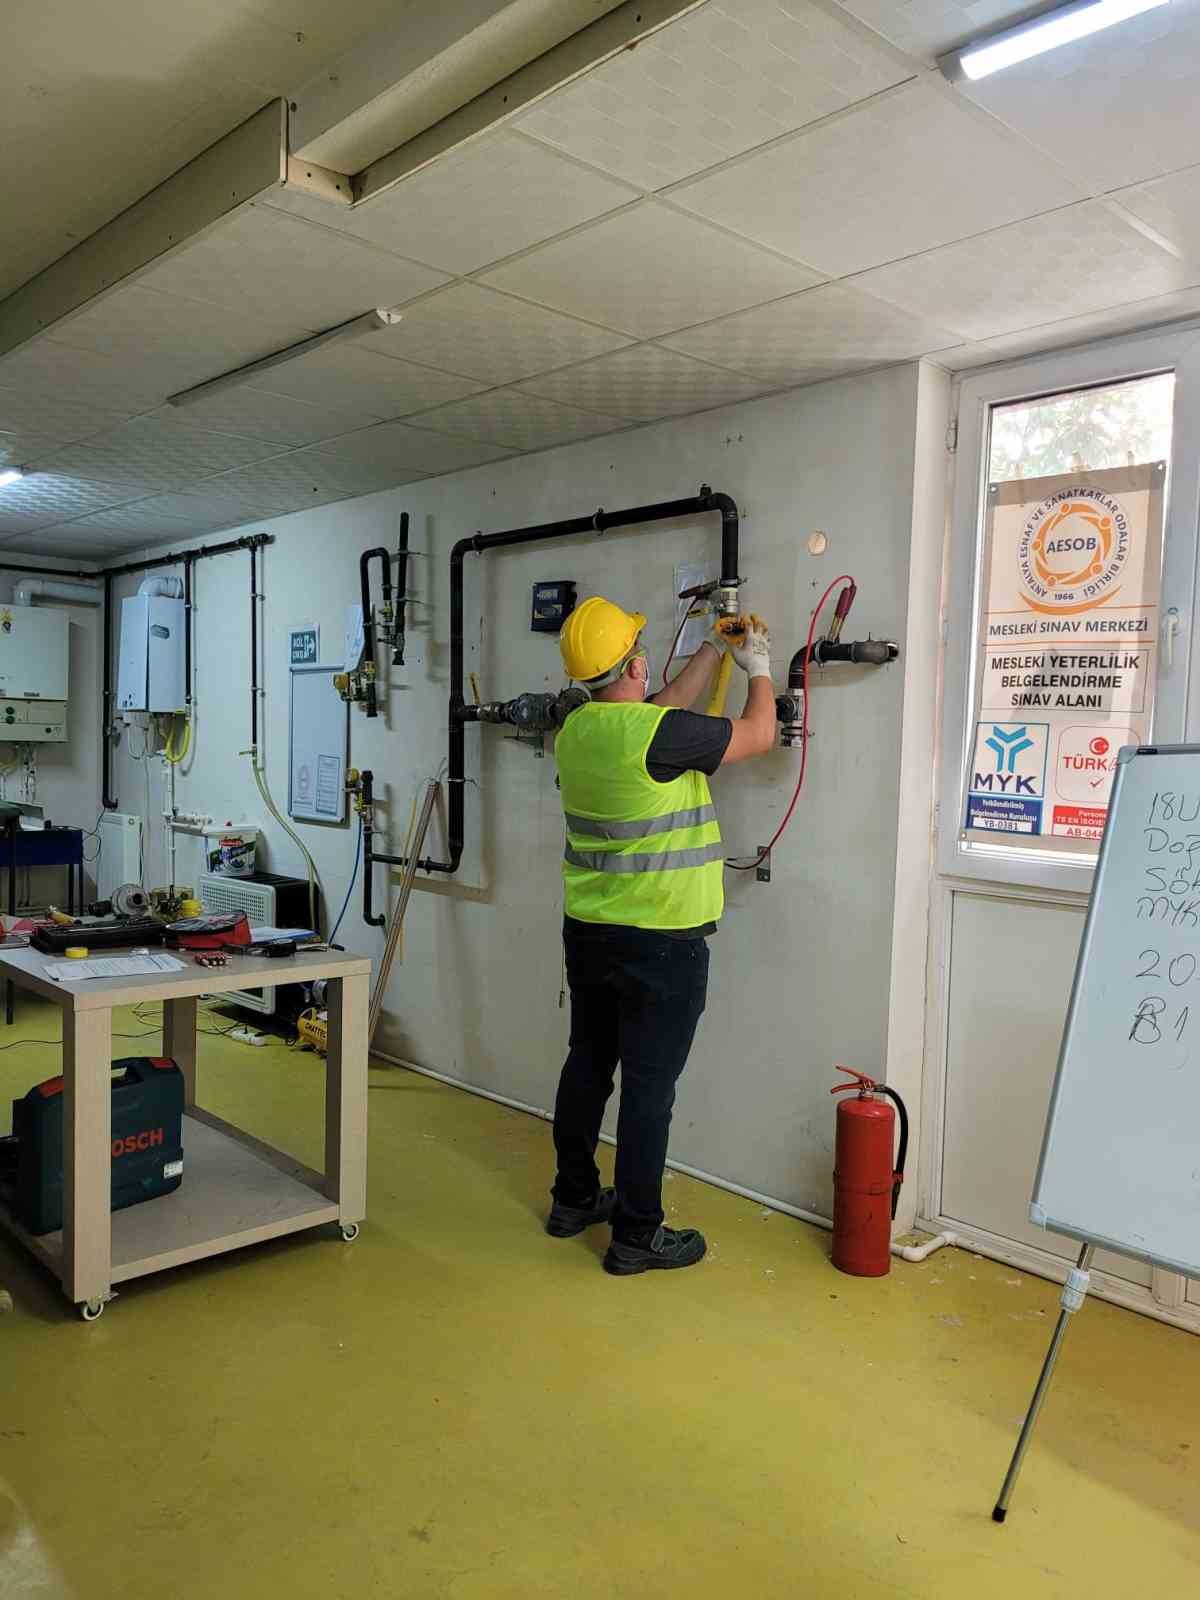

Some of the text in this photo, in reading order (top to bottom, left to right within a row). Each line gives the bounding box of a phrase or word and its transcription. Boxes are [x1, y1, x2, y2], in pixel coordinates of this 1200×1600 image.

[1020, 487, 1129, 598] ANTALYA ESNAF VE SANATKARLAR ODALAR BİRLİĞİ
[1046, 537, 1097, 554] AESOB
[1054, 593, 1075, 601] 1966
[989, 617, 1148, 637] MESLEKİ SINAV MERKEZİ
[991, 653, 1141, 670] MESLEKİ YETERLİLİK
[1001, 673, 1123, 689] BELGELENDİRME
[1011, 694, 1103, 708] SINAV ALANI
[973, 773, 1038, 794] MYK
[1135, 949, 1200, 986] 20
[111, 1128, 165, 1158] OSCH
